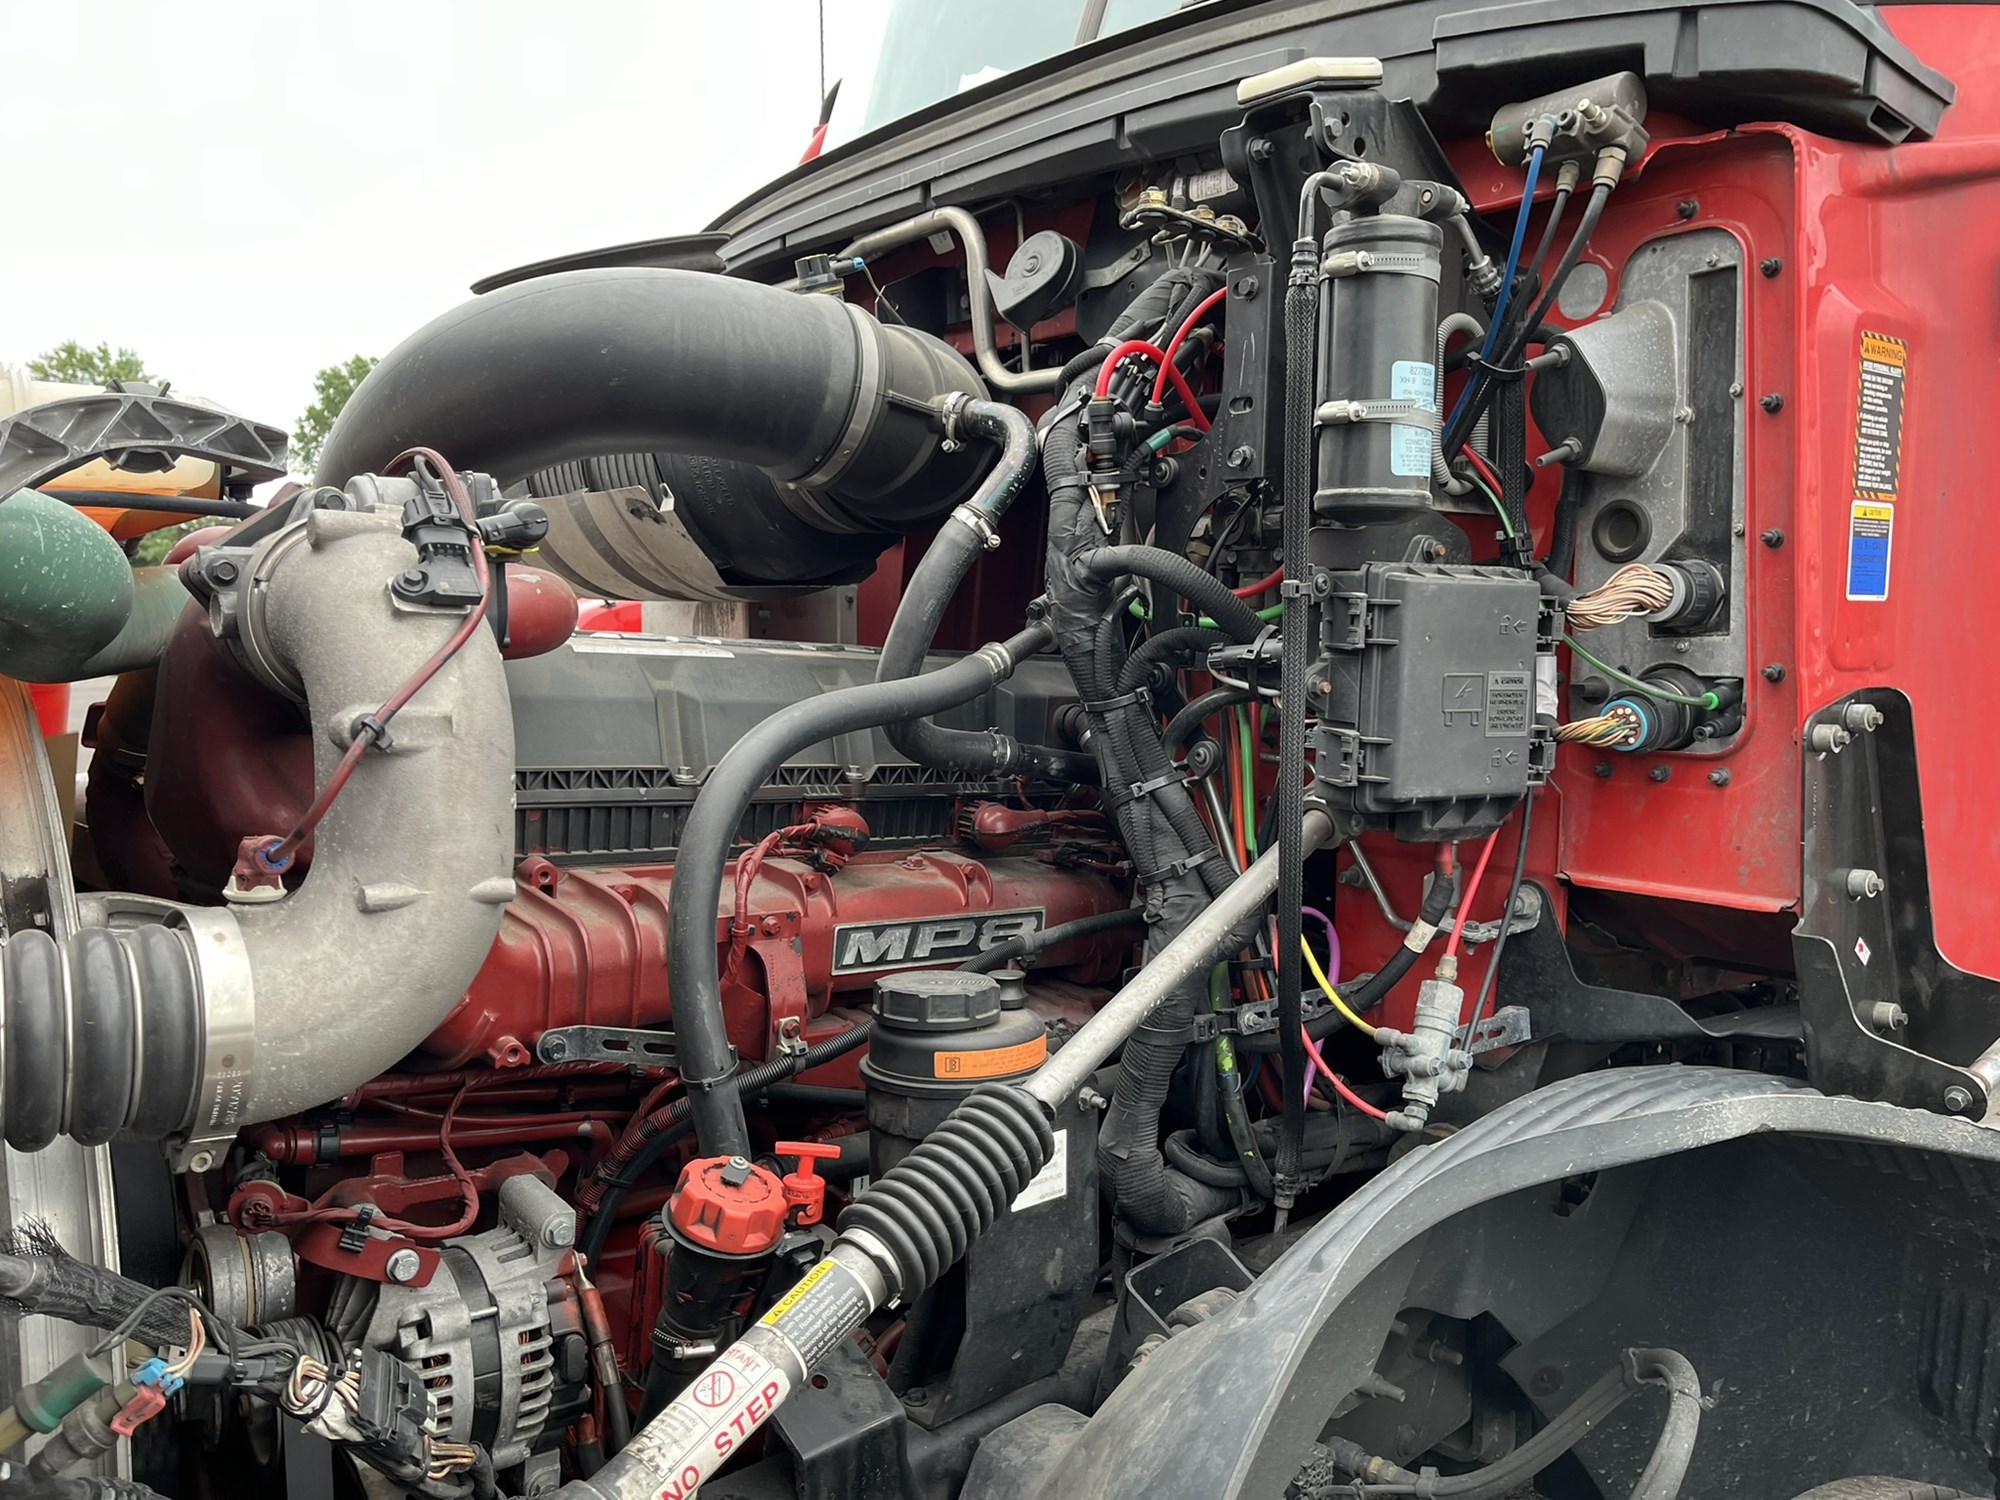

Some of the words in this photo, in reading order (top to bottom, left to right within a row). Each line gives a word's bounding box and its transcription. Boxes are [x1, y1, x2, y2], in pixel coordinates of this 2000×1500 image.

[1871, 344, 1902, 361] WARNING
[841, 915, 1038, 966] MP8
[783, 1268, 826, 1307] CAUTION
[788, 1298, 807, 1317] vehicle
[811, 1271, 834, 1295] equipped
[783, 1321, 795, 1333] with
[794, 1312, 804, 1322] the
[803, 1298, 818, 1313] Mack
[789, 1328, 801, 1339] Inc.
[799, 1314, 815, 1329] Road
[813, 1294, 835, 1316] Stability
[795, 1318, 824, 1347] Advantage
[821, 1304, 838, 1320] (RSA)
[836, 1286, 856, 1306] system.
[800, 1330, 823, 1354] Removal
[828, 1316, 838, 1325] the
[837, 1296, 858, 1317] steering
[804, 1347, 818, 1361] shaft
[823, 1327, 837, 1341] other
[837, 1306, 859, 1328] changes
[816, 1337, 837, 1359] steering
[835, 1307, 866, 1338] components
[661, 1465, 699, 1500] NO
[714, 1382, 779, 1458] STEP
